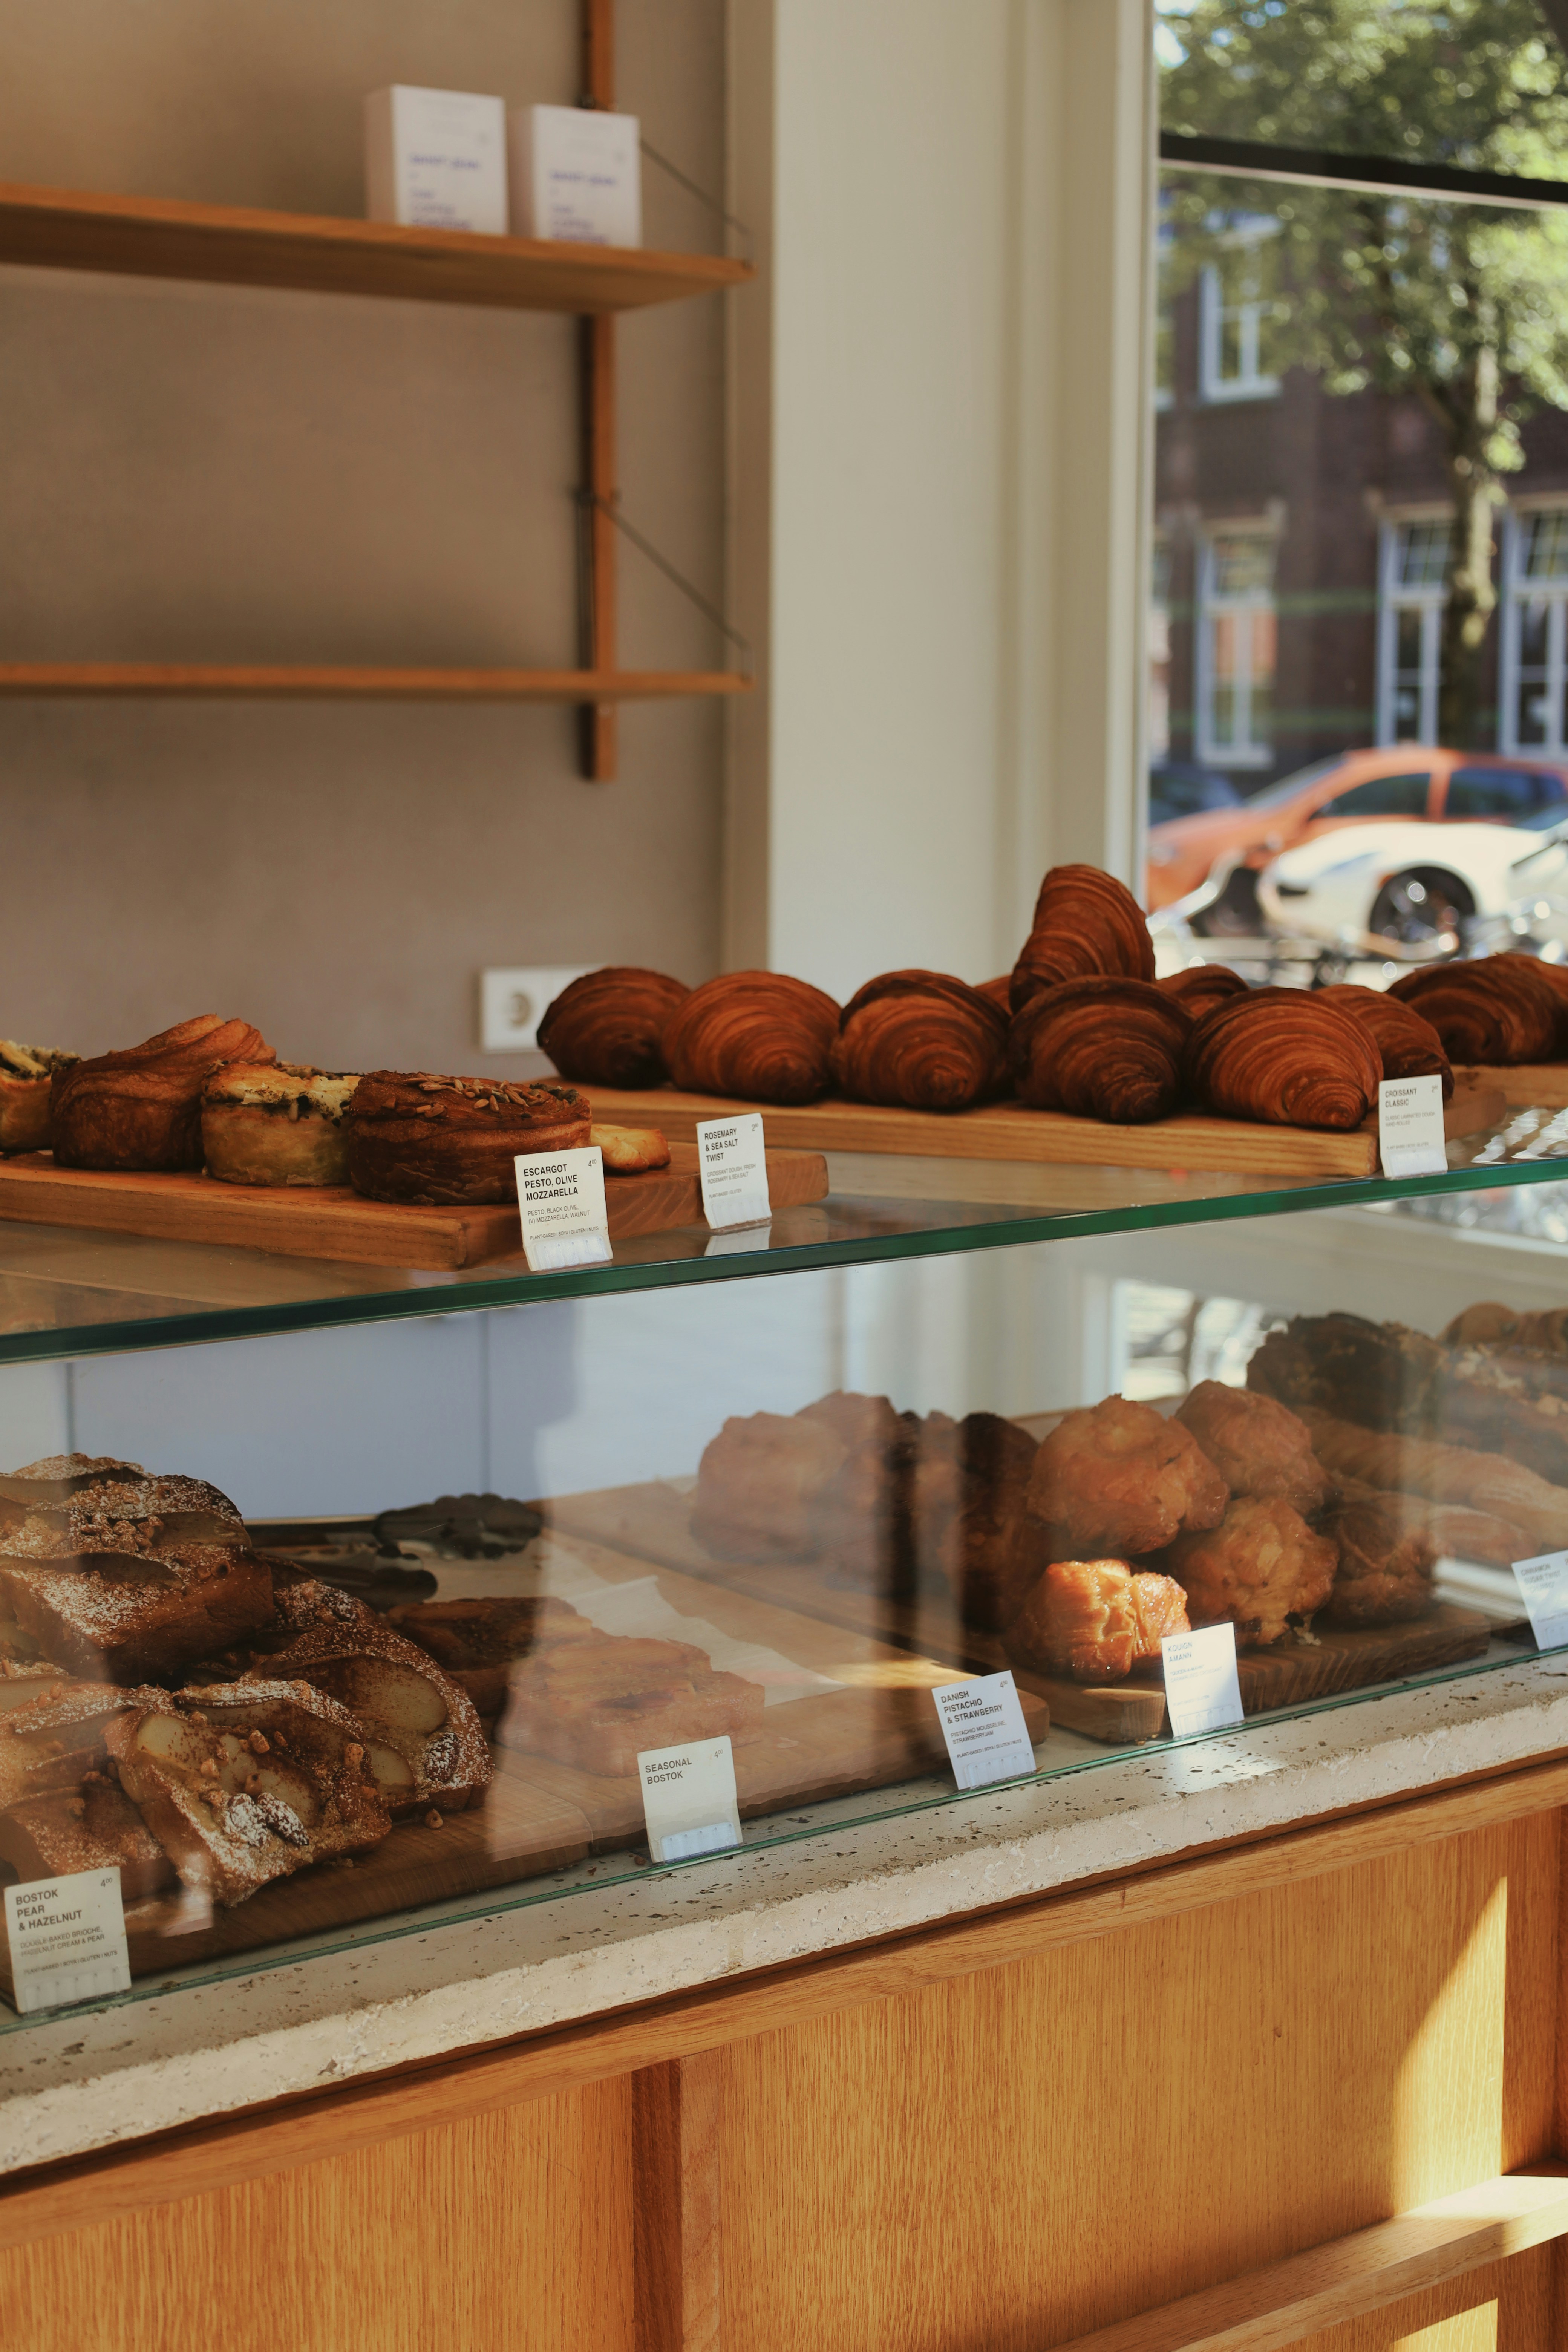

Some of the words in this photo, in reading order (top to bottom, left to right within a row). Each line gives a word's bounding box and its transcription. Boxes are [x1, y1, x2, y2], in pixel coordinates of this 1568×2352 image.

[1386, 1088, 1416, 1098] CROISSANT
[1386, 1099, 1409, 1107] CLASSIC
[705, 1129, 736, 1140] ROSEMARY
[724, 1139, 738, 1148] SALT
[706, 1153, 724, 1162] TWIST
[524, 1164, 567, 1176] ESCARGOT
[707, 1168, 728, 1177] CROISSANT
[525, 1178, 553, 1188] PESTO,
[556, 1175, 577, 1185] OLIVE
[527, 1187, 578, 1200] MOZZARELLA
[537, 1214, 569, 1222] MOZZARELLA,
[1168, 1642, 1192, 1652] KOUIGN
[941, 1690, 969, 1703] DANISH
[944, 1698, 982, 1713] PISTACHIO
[954, 1705, 1002, 1722] STRAWBERRY
[951, 1728, 976, 1737] PISTACHIO
[645, 1758, 692, 1773] SEASONAL
[647, 1771, 683, 1784] BOSTOK
[101, 1877, 112, 1887] 400
[16, 1889, 58, 1905] BOSTOK
[17, 1905, 44, 1918] PEAR
[19, 1923, 25, 1931] &
[29, 1910, 81, 1929] HAZELNUT
[49, 1933, 70, 1942] BAKED
[57, 1939, 80, 1949] CREAM
